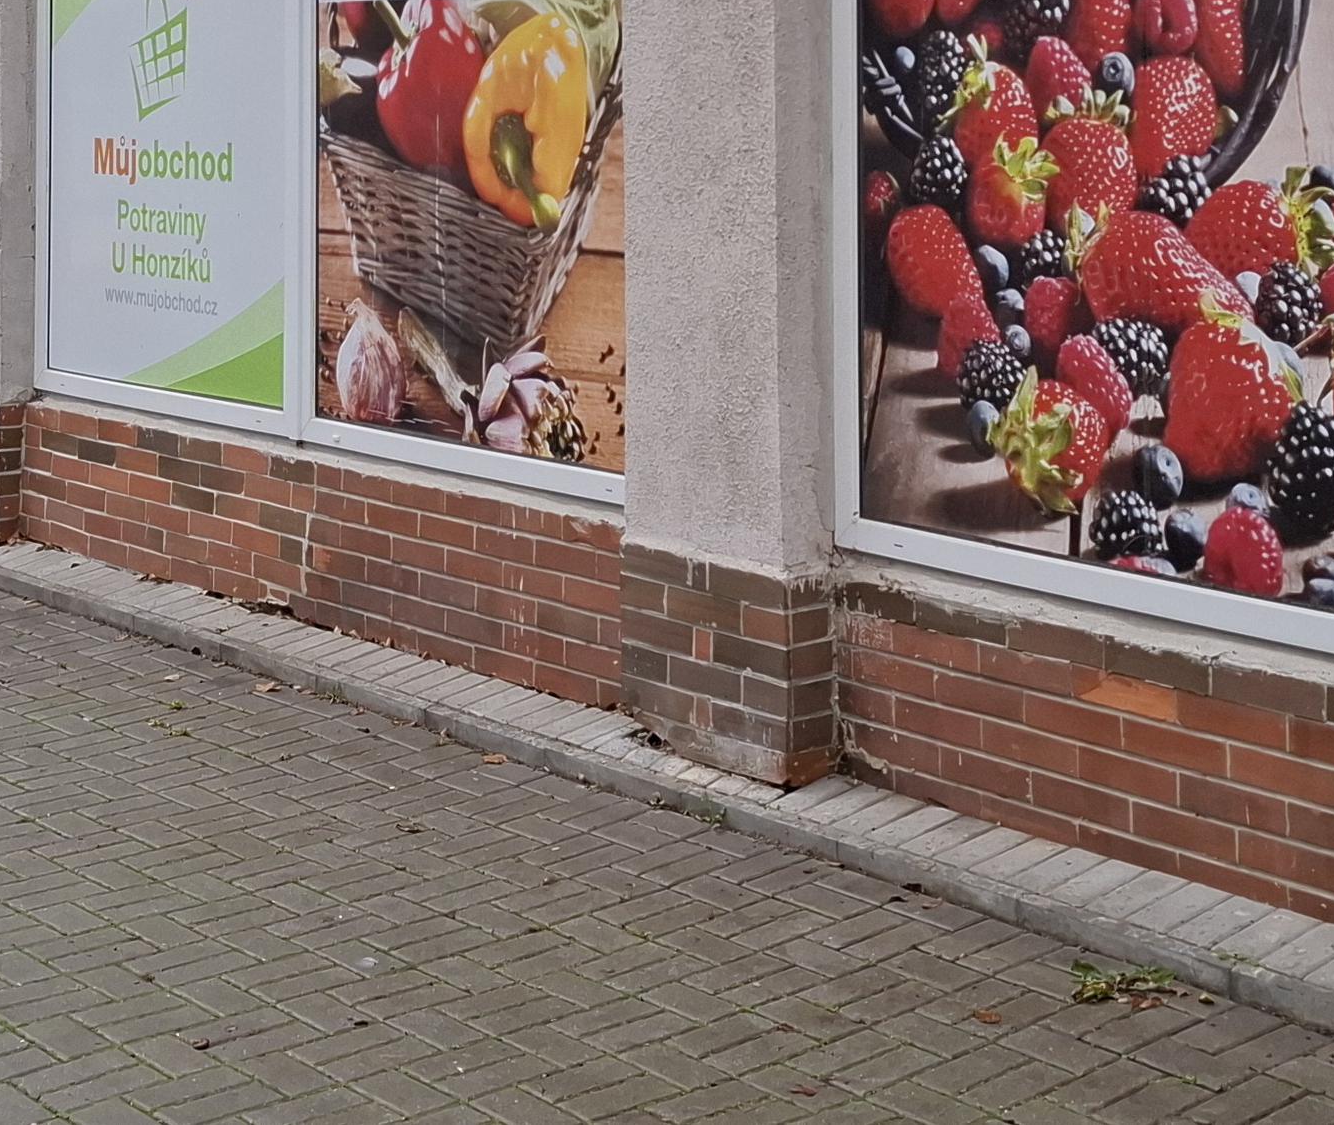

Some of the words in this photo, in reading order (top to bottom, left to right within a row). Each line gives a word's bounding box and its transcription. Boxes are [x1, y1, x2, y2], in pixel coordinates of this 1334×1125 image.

[94, 136, 233, 185] Můjobchod
[117, 199, 207, 244] Potraviny
[112, 242, 126, 273] U
[132, 243, 212, 283] Honzíků
[105, 286, 219, 316] www.mujobchod.cz
